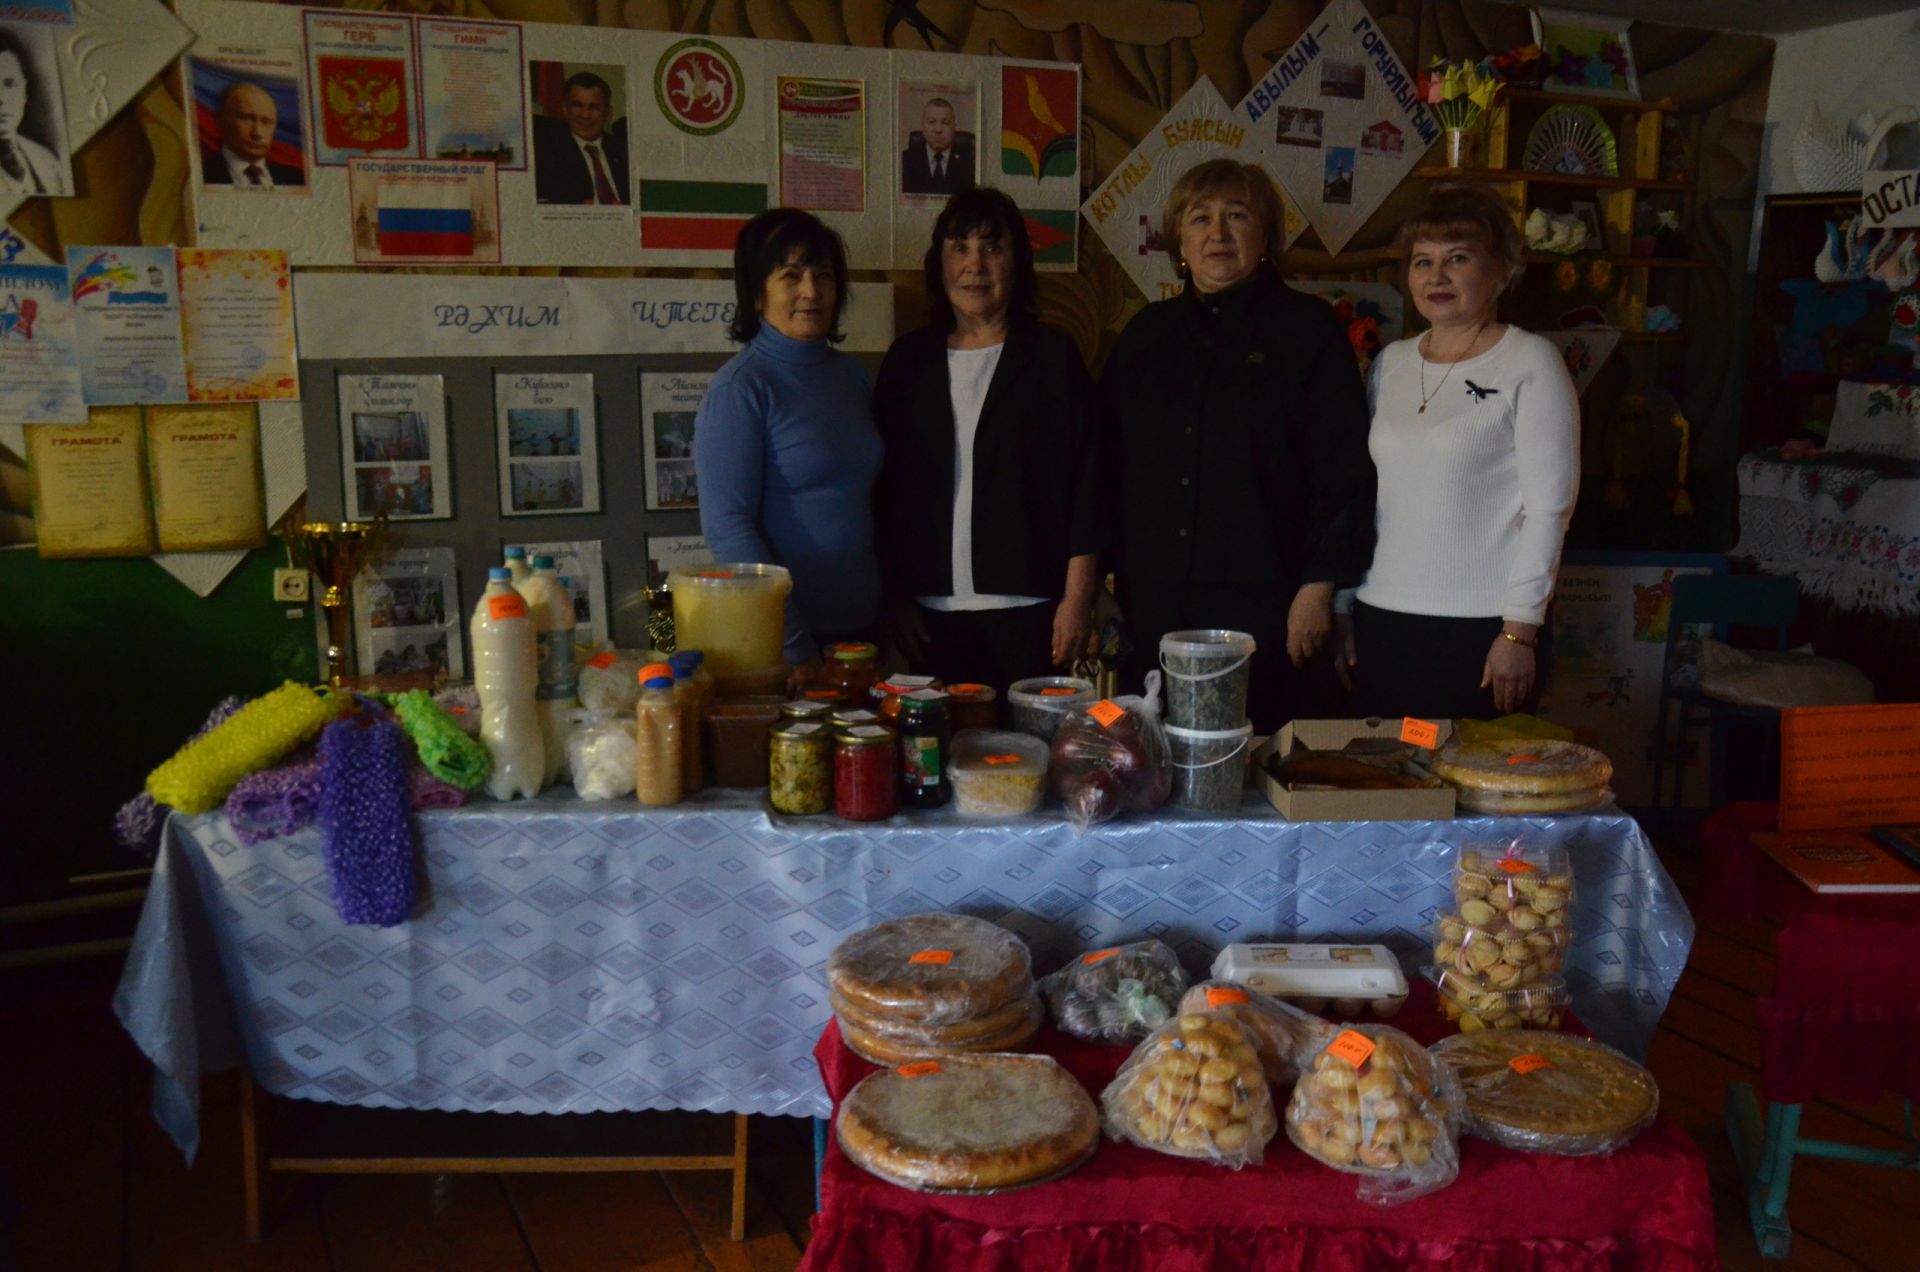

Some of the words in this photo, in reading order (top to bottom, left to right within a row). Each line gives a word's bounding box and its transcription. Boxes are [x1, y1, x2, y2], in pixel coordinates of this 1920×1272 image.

[343, 30, 376, 42] ГЕРБ
[454, 34, 487, 45] ГИМН
[1244, 31, 1321, 123] АВЫЛЫМ
[356, 162, 459, 174] ГОСУДАРСТВЕННЫЙ
[460, 165, 488, 175] ФЛАГ
[632, 300, 735, 329] ИТЕГЕ
[51, 437, 121, 447] ГРАМОТА
[171, 432, 238, 443] ГРАМОТА
